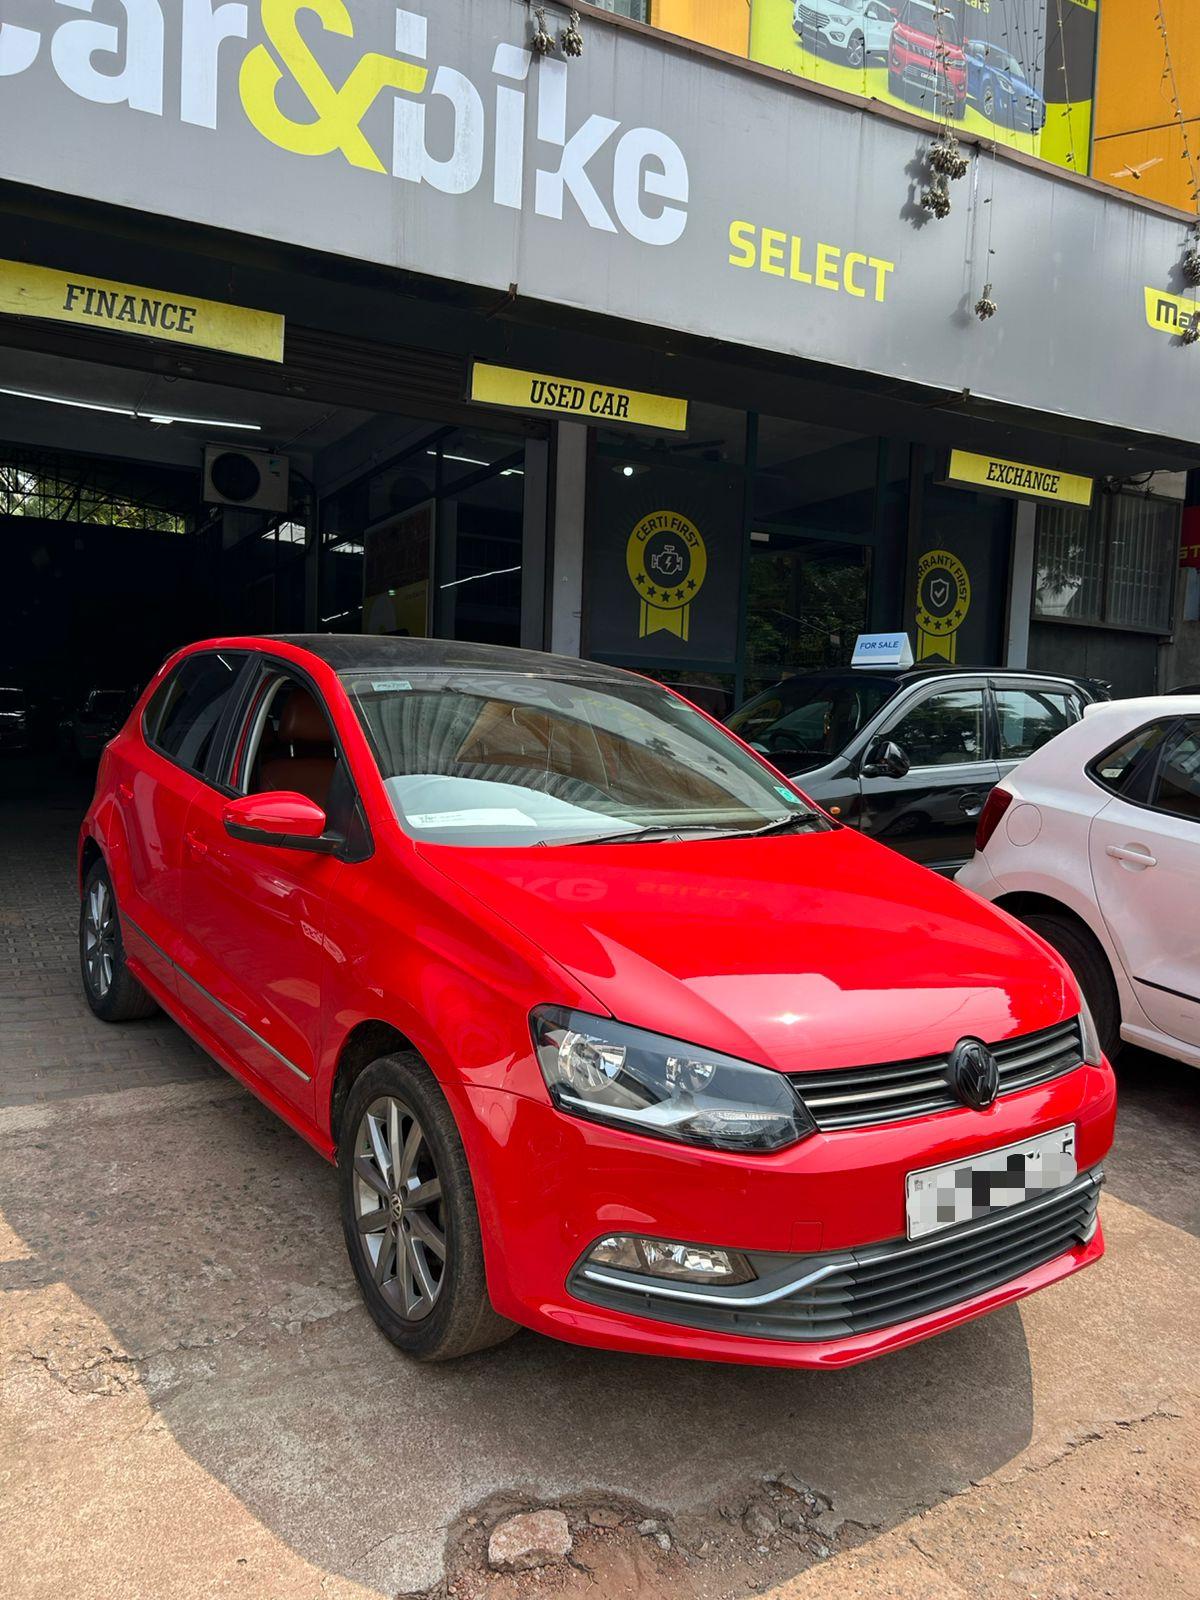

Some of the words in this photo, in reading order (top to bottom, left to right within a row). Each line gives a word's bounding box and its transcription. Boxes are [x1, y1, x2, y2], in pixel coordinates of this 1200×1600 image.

[728, 219, 895, 303] SELECT
[62, 283, 197, 334] FINANCE
[529, 379, 585, 411] USED
[589, 390, 630, 418] CAR
[986, 461, 1060, 494] EXCHANGE
[635, 515, 668, 542] CERTI
[671, 516, 700, 548] FIRST
[953, 566, 968, 602] FIRST
[859, 642, 876, 650] FOR
[878, 640, 899, 649] SALE
